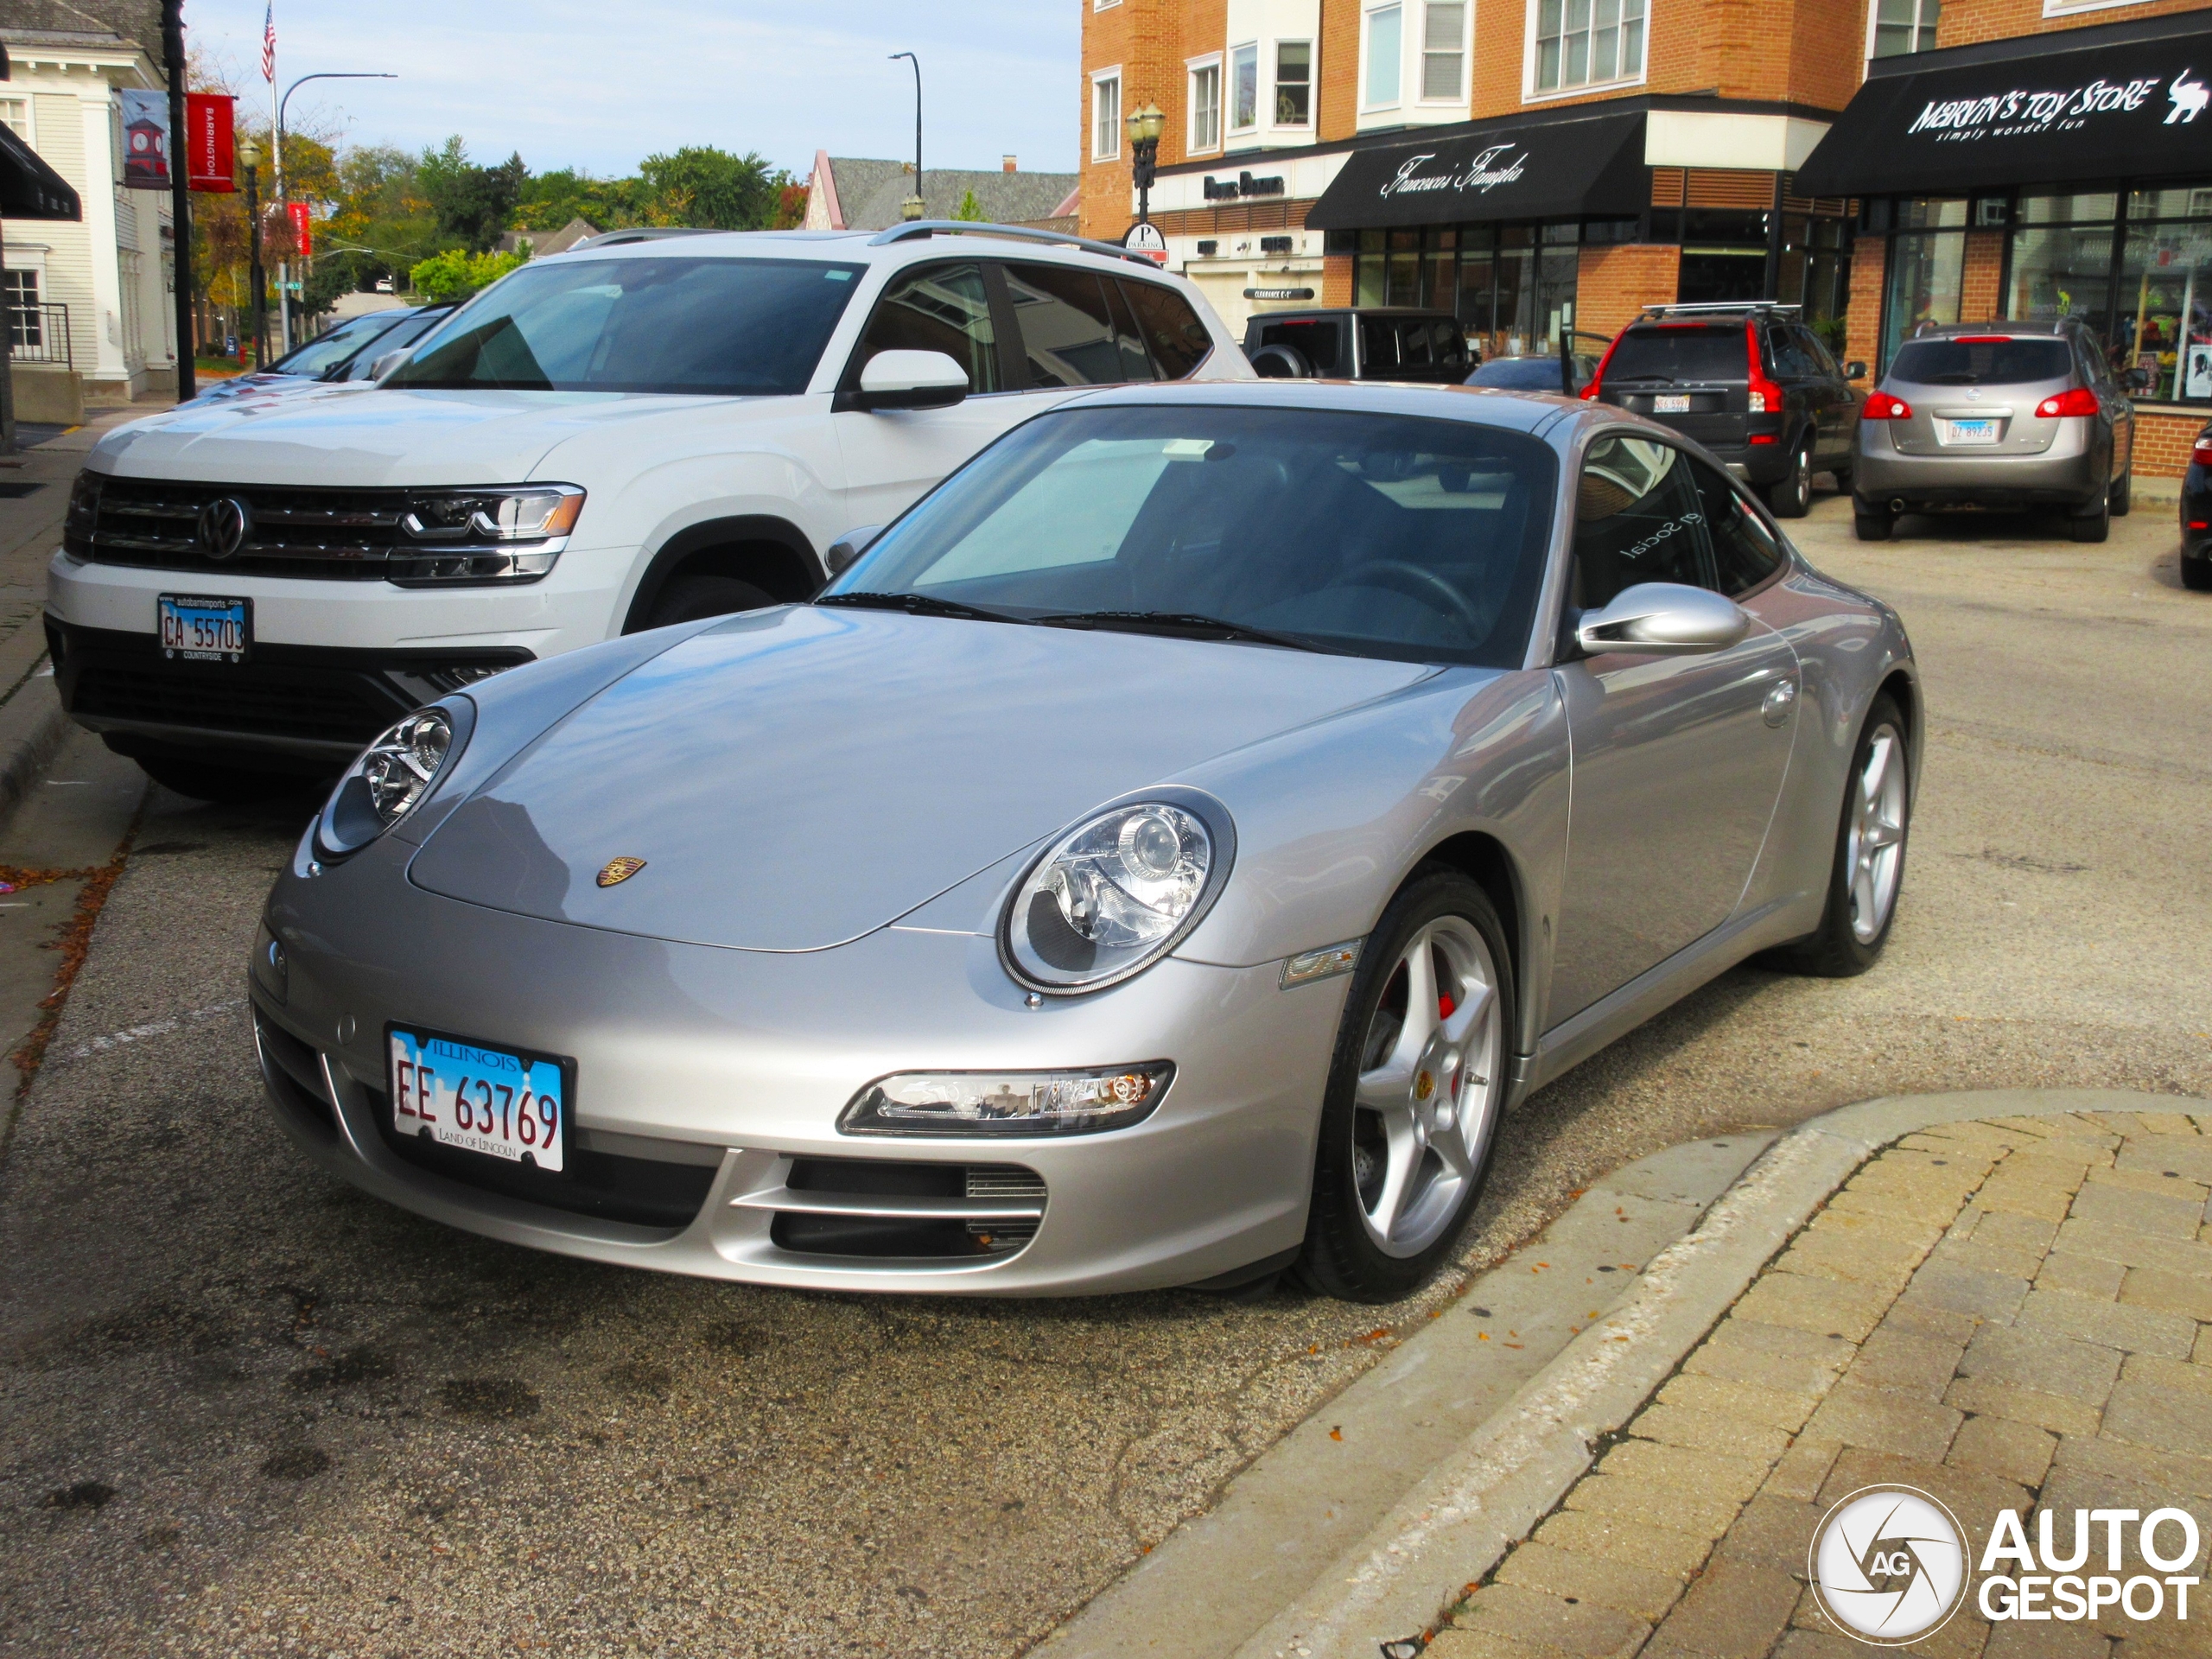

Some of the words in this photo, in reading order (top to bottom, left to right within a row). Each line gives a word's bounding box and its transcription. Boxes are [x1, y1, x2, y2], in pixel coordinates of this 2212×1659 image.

[2070, 78, 2161, 116] STORE
[206, 107, 216, 175] BARRINGTON
[1936, 129, 1986, 142] simply
[1993, 122, 2052, 137] wonder
[2056, 118, 2086, 130] fun
[1454, 143, 1529, 194] Famiglia
[1140, 226, 1151, 242] P
[1966, 427, 1993, 437] 89235
[164, 616, 184, 646] CA
[194, 617, 245, 650] 55703
[183, 651, 222, 661] COUNTRYSIDE
[433, 1040, 518, 1072] ILLINOIS
[397, 1059, 436, 1123] EE
[455, 1076, 558, 1150] 63769
[439, 1128, 464, 1145] LAND
[465, 1137, 478, 1147] OF
[479, 1137, 517, 1158] LINCOLN
